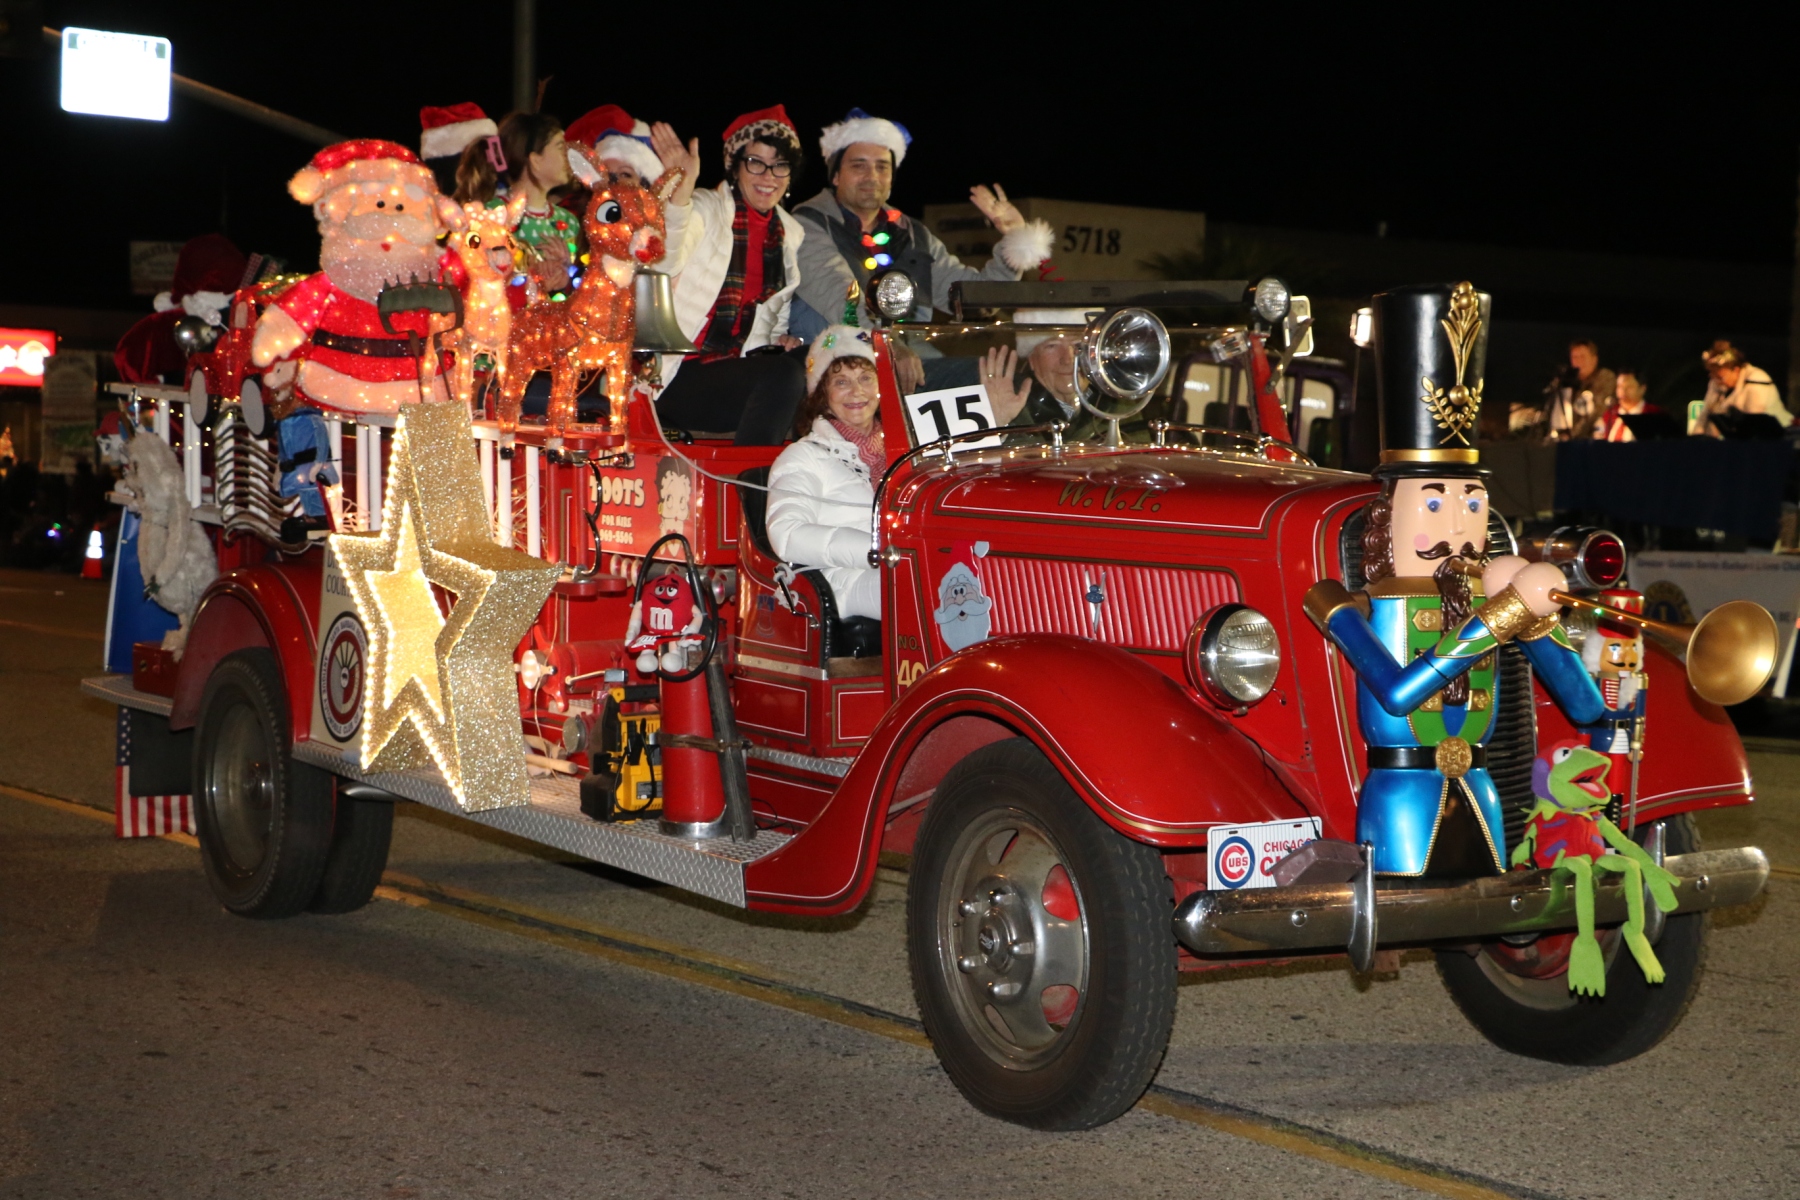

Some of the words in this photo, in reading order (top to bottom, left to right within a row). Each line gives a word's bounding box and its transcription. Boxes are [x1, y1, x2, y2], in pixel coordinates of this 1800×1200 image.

[1062, 225, 1122, 256] 5718
[917, 393, 989, 443] 15
[589, 475, 645, 508] TOOTS
[602, 514, 615, 527] FOR
[898, 635, 921, 650] NO.
